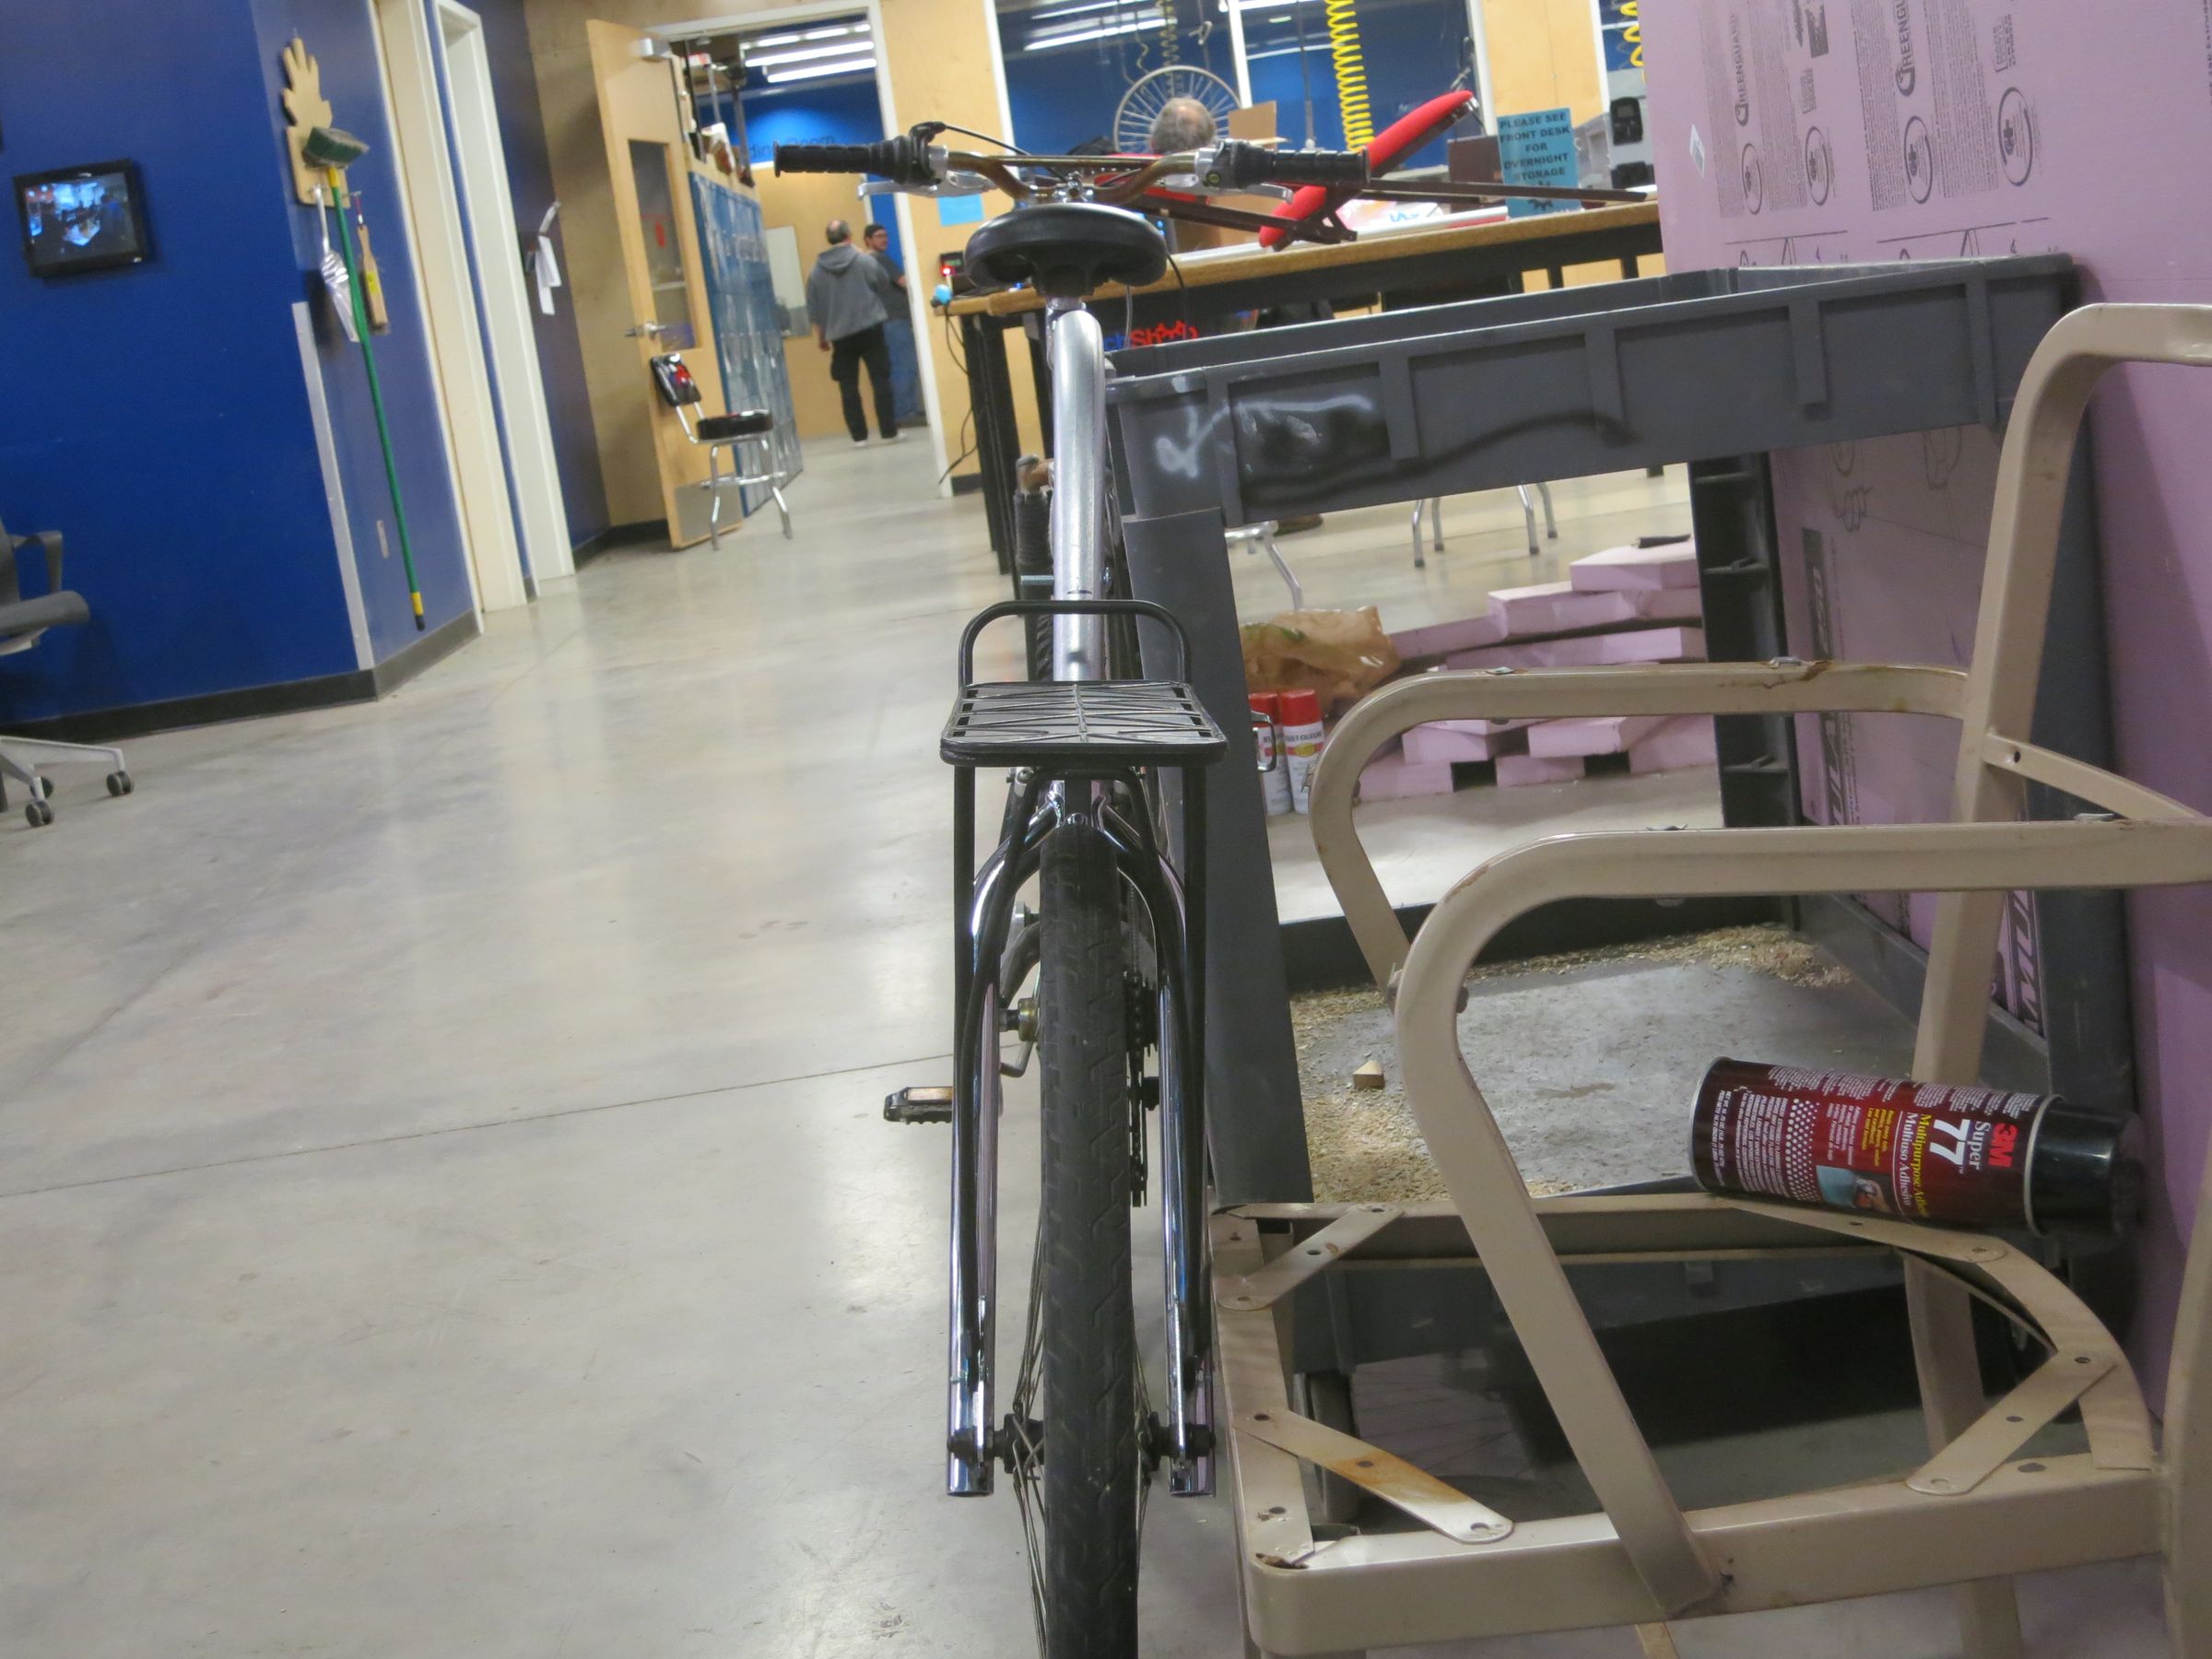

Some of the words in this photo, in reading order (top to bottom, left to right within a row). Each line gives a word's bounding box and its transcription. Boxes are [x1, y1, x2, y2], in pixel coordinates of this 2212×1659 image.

[1895, 0, 1915, 97] GREENGU
[1500, 115, 1542, 128] PLEASE
[1546, 112, 1567, 123] SEE
[1500, 131, 1536, 142] FRONT
[1540, 126, 1571, 138] DESK
[1503, 152, 1569, 170] OVERNIGHT
[1525, 142, 1548, 152] FOR
[1513, 166, 1566, 181] STORAGE
[1899, 1112, 1919, 1161] Multiuso
[1910, 1112, 1933, 1187] Multipurpose
[1929, 1118, 1971, 1166] 77
[1967, 1120, 1992, 1171] Super
[1988, 1122, 2018, 1168] 3M
[1899, 1161, 1913, 1206] Adhesivo
